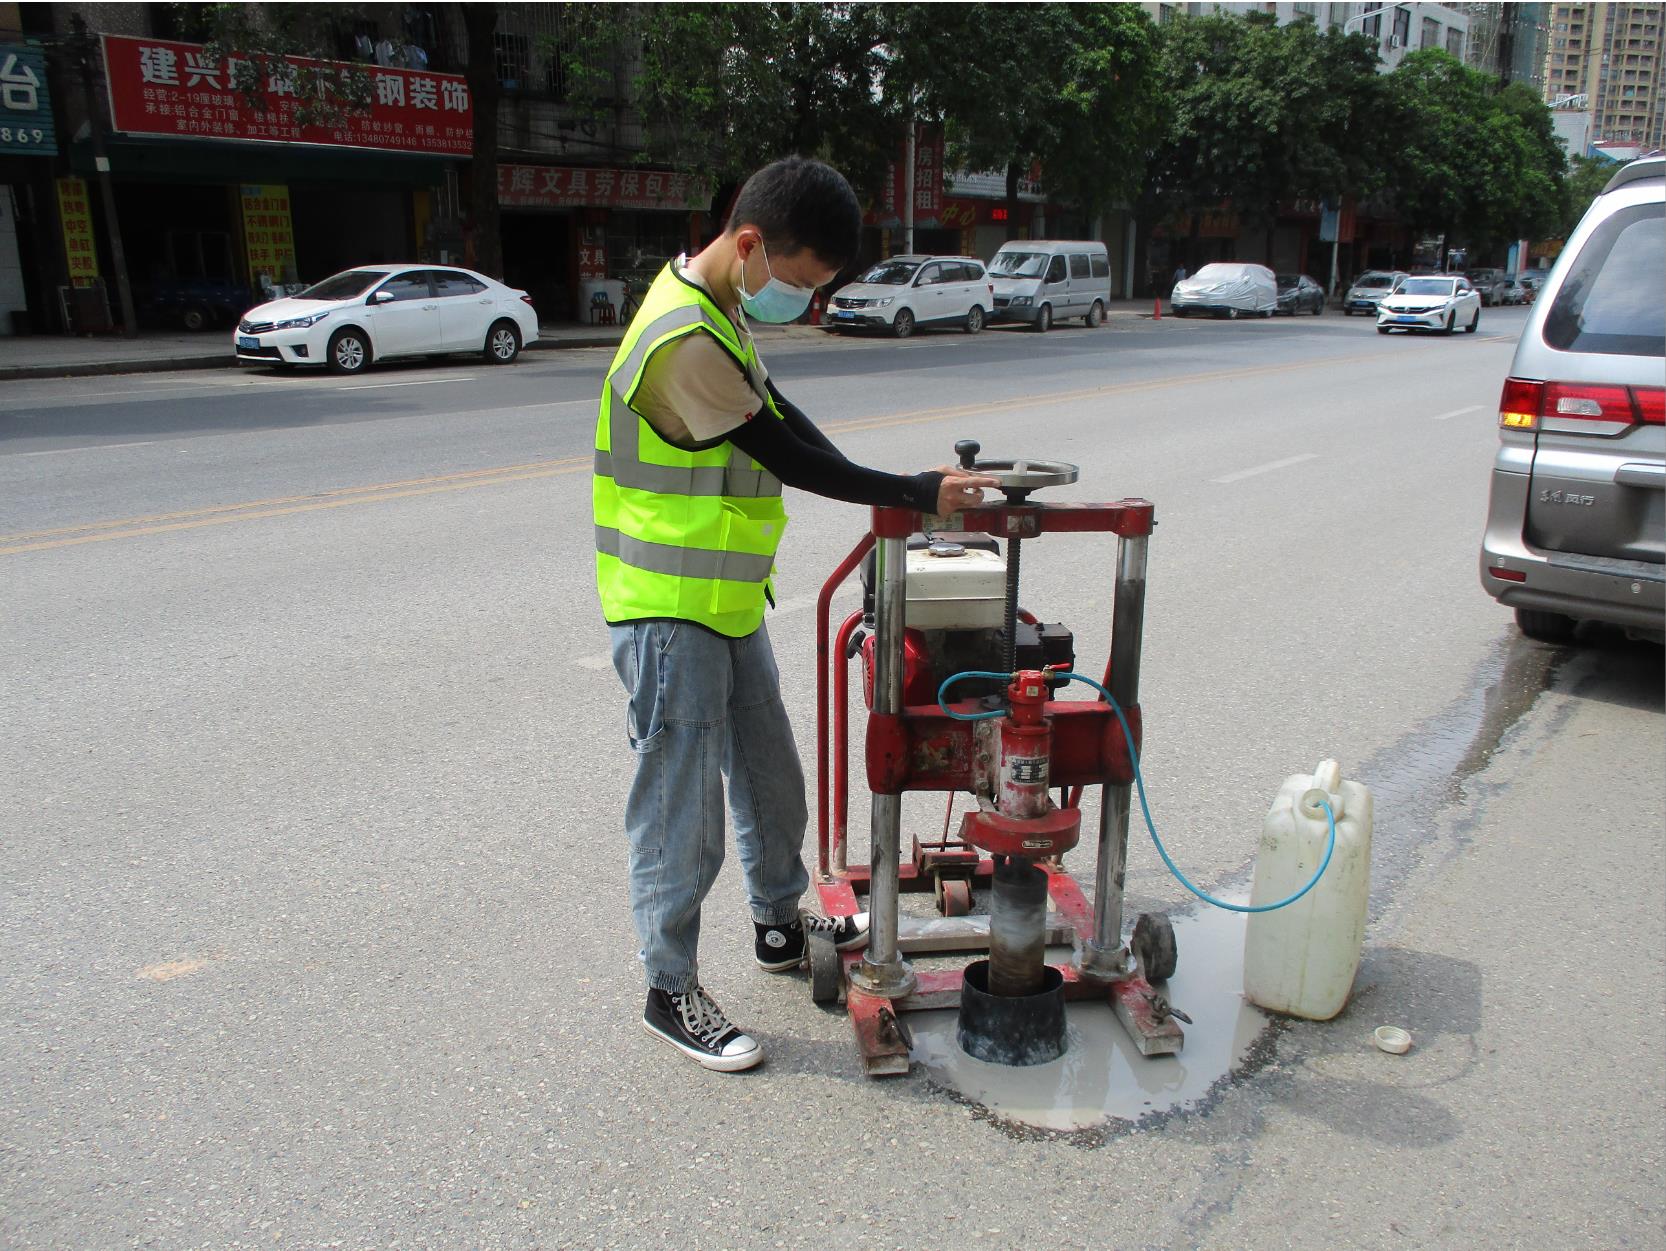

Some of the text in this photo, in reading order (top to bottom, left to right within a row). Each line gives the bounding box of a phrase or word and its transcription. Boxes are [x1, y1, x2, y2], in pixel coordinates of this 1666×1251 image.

[0, 53, 40, 112] 台
[139, 46, 469, 113] 建兴璃不钢装饰
[1, 127, 43, 144] 869
[579, 248, 605, 265] 文具
